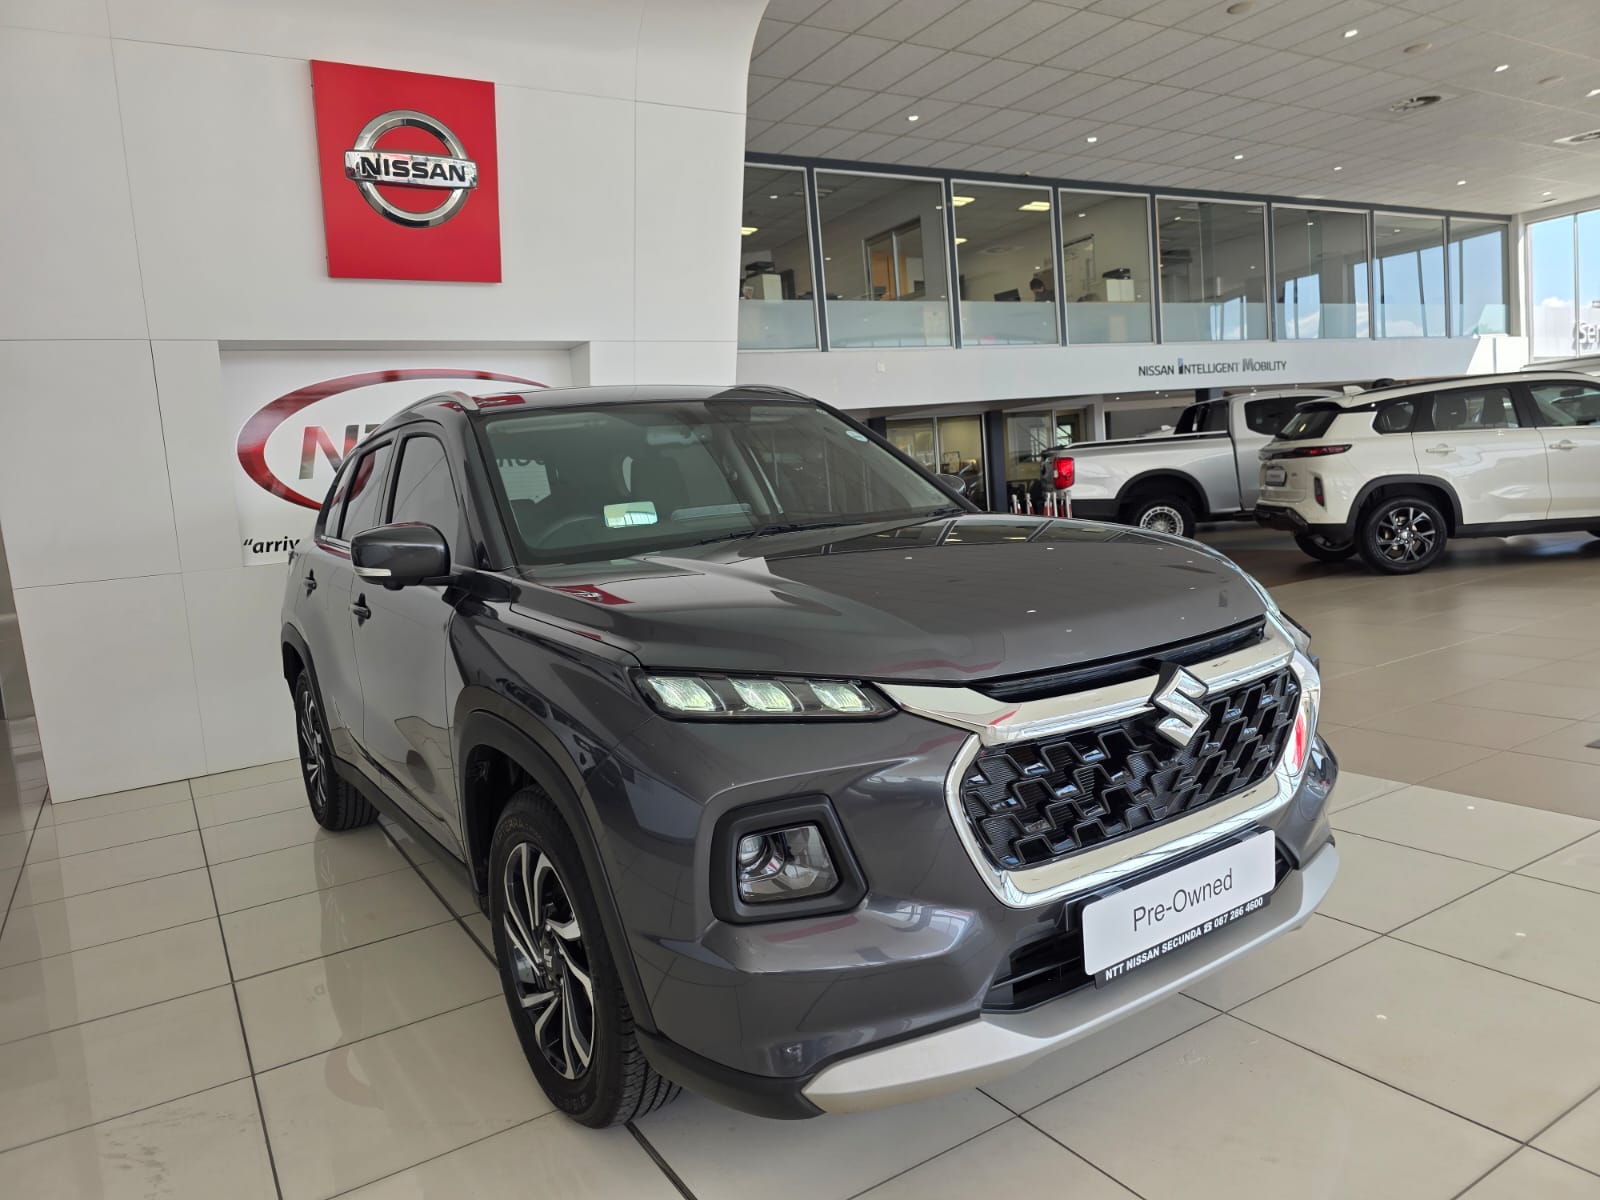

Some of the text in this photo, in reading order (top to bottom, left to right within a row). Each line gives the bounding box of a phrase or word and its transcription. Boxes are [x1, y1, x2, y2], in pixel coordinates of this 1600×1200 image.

[361, 156, 467, 183] NISSAN
[1138, 357, 1287, 377] NISSAN INTELLIGENT MOBILITY
[1132, 867, 1234, 932] Pre-Owned
[1104, 962, 1125, 981] NTT
[1126, 945, 1161, 972] NISSAN
[1161, 927, 1202, 954] SECUNDA
